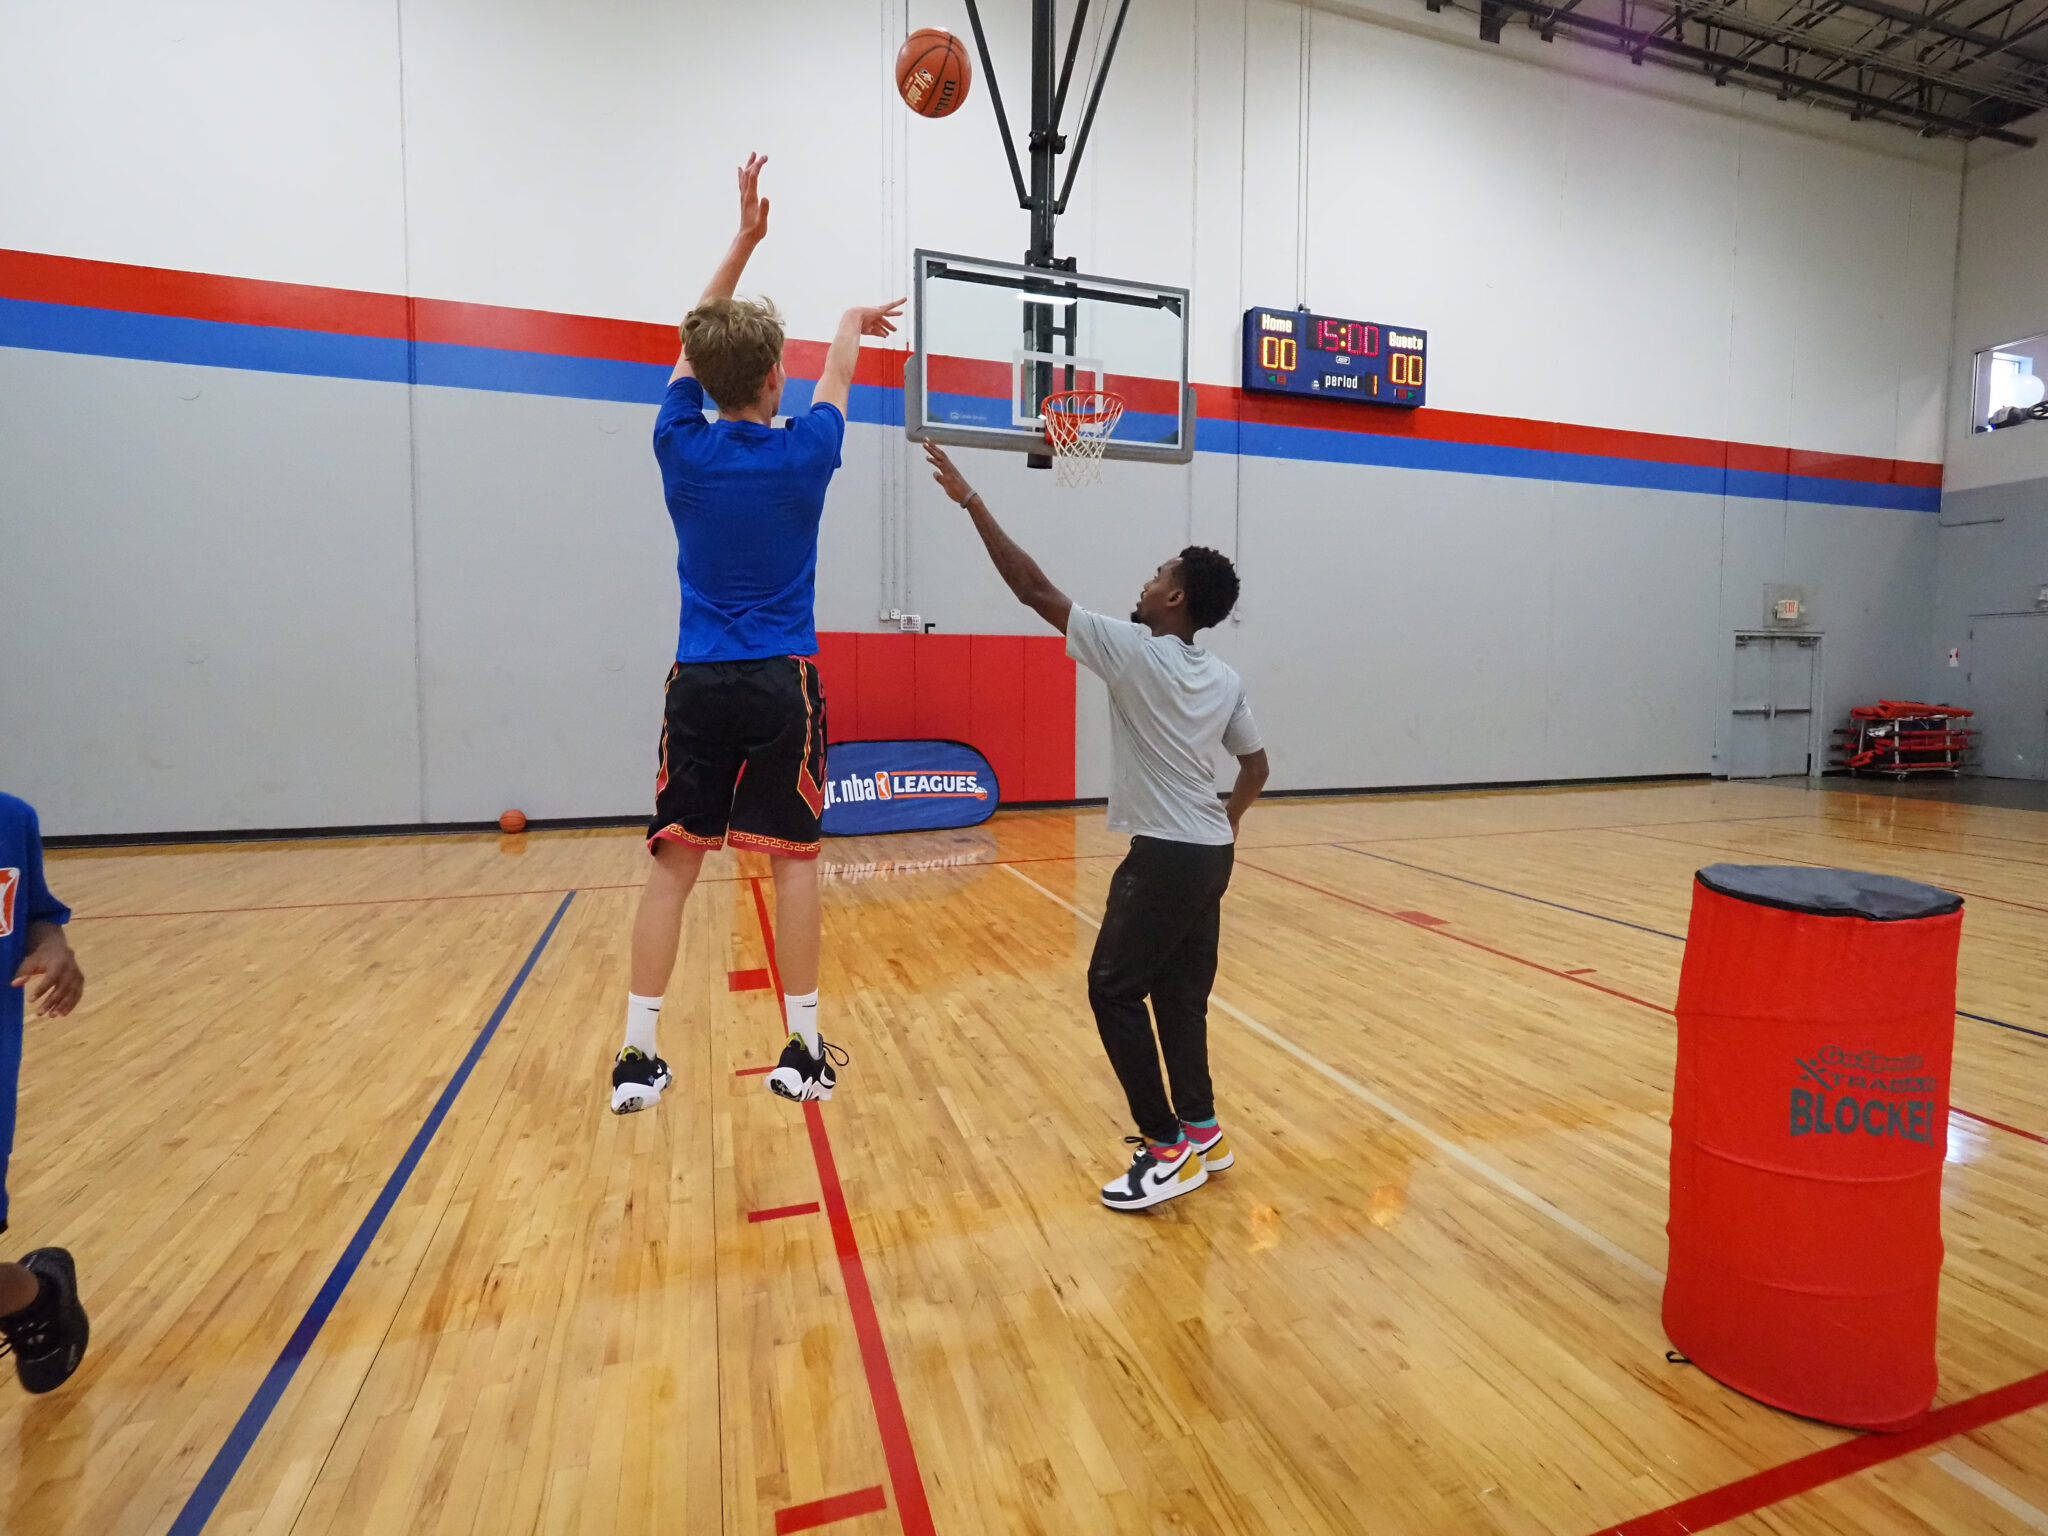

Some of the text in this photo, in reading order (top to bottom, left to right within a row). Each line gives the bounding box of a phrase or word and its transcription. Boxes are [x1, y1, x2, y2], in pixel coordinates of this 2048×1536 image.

[1262, 314, 1292, 333] Home
[1318, 320, 1379, 357] 15:00
[1262, 336, 1297, 371] 00
[1325, 375, 1358, 389] period
[1392, 353, 1423, 386] 00
[893, 775, 977, 794] LEAGUES
